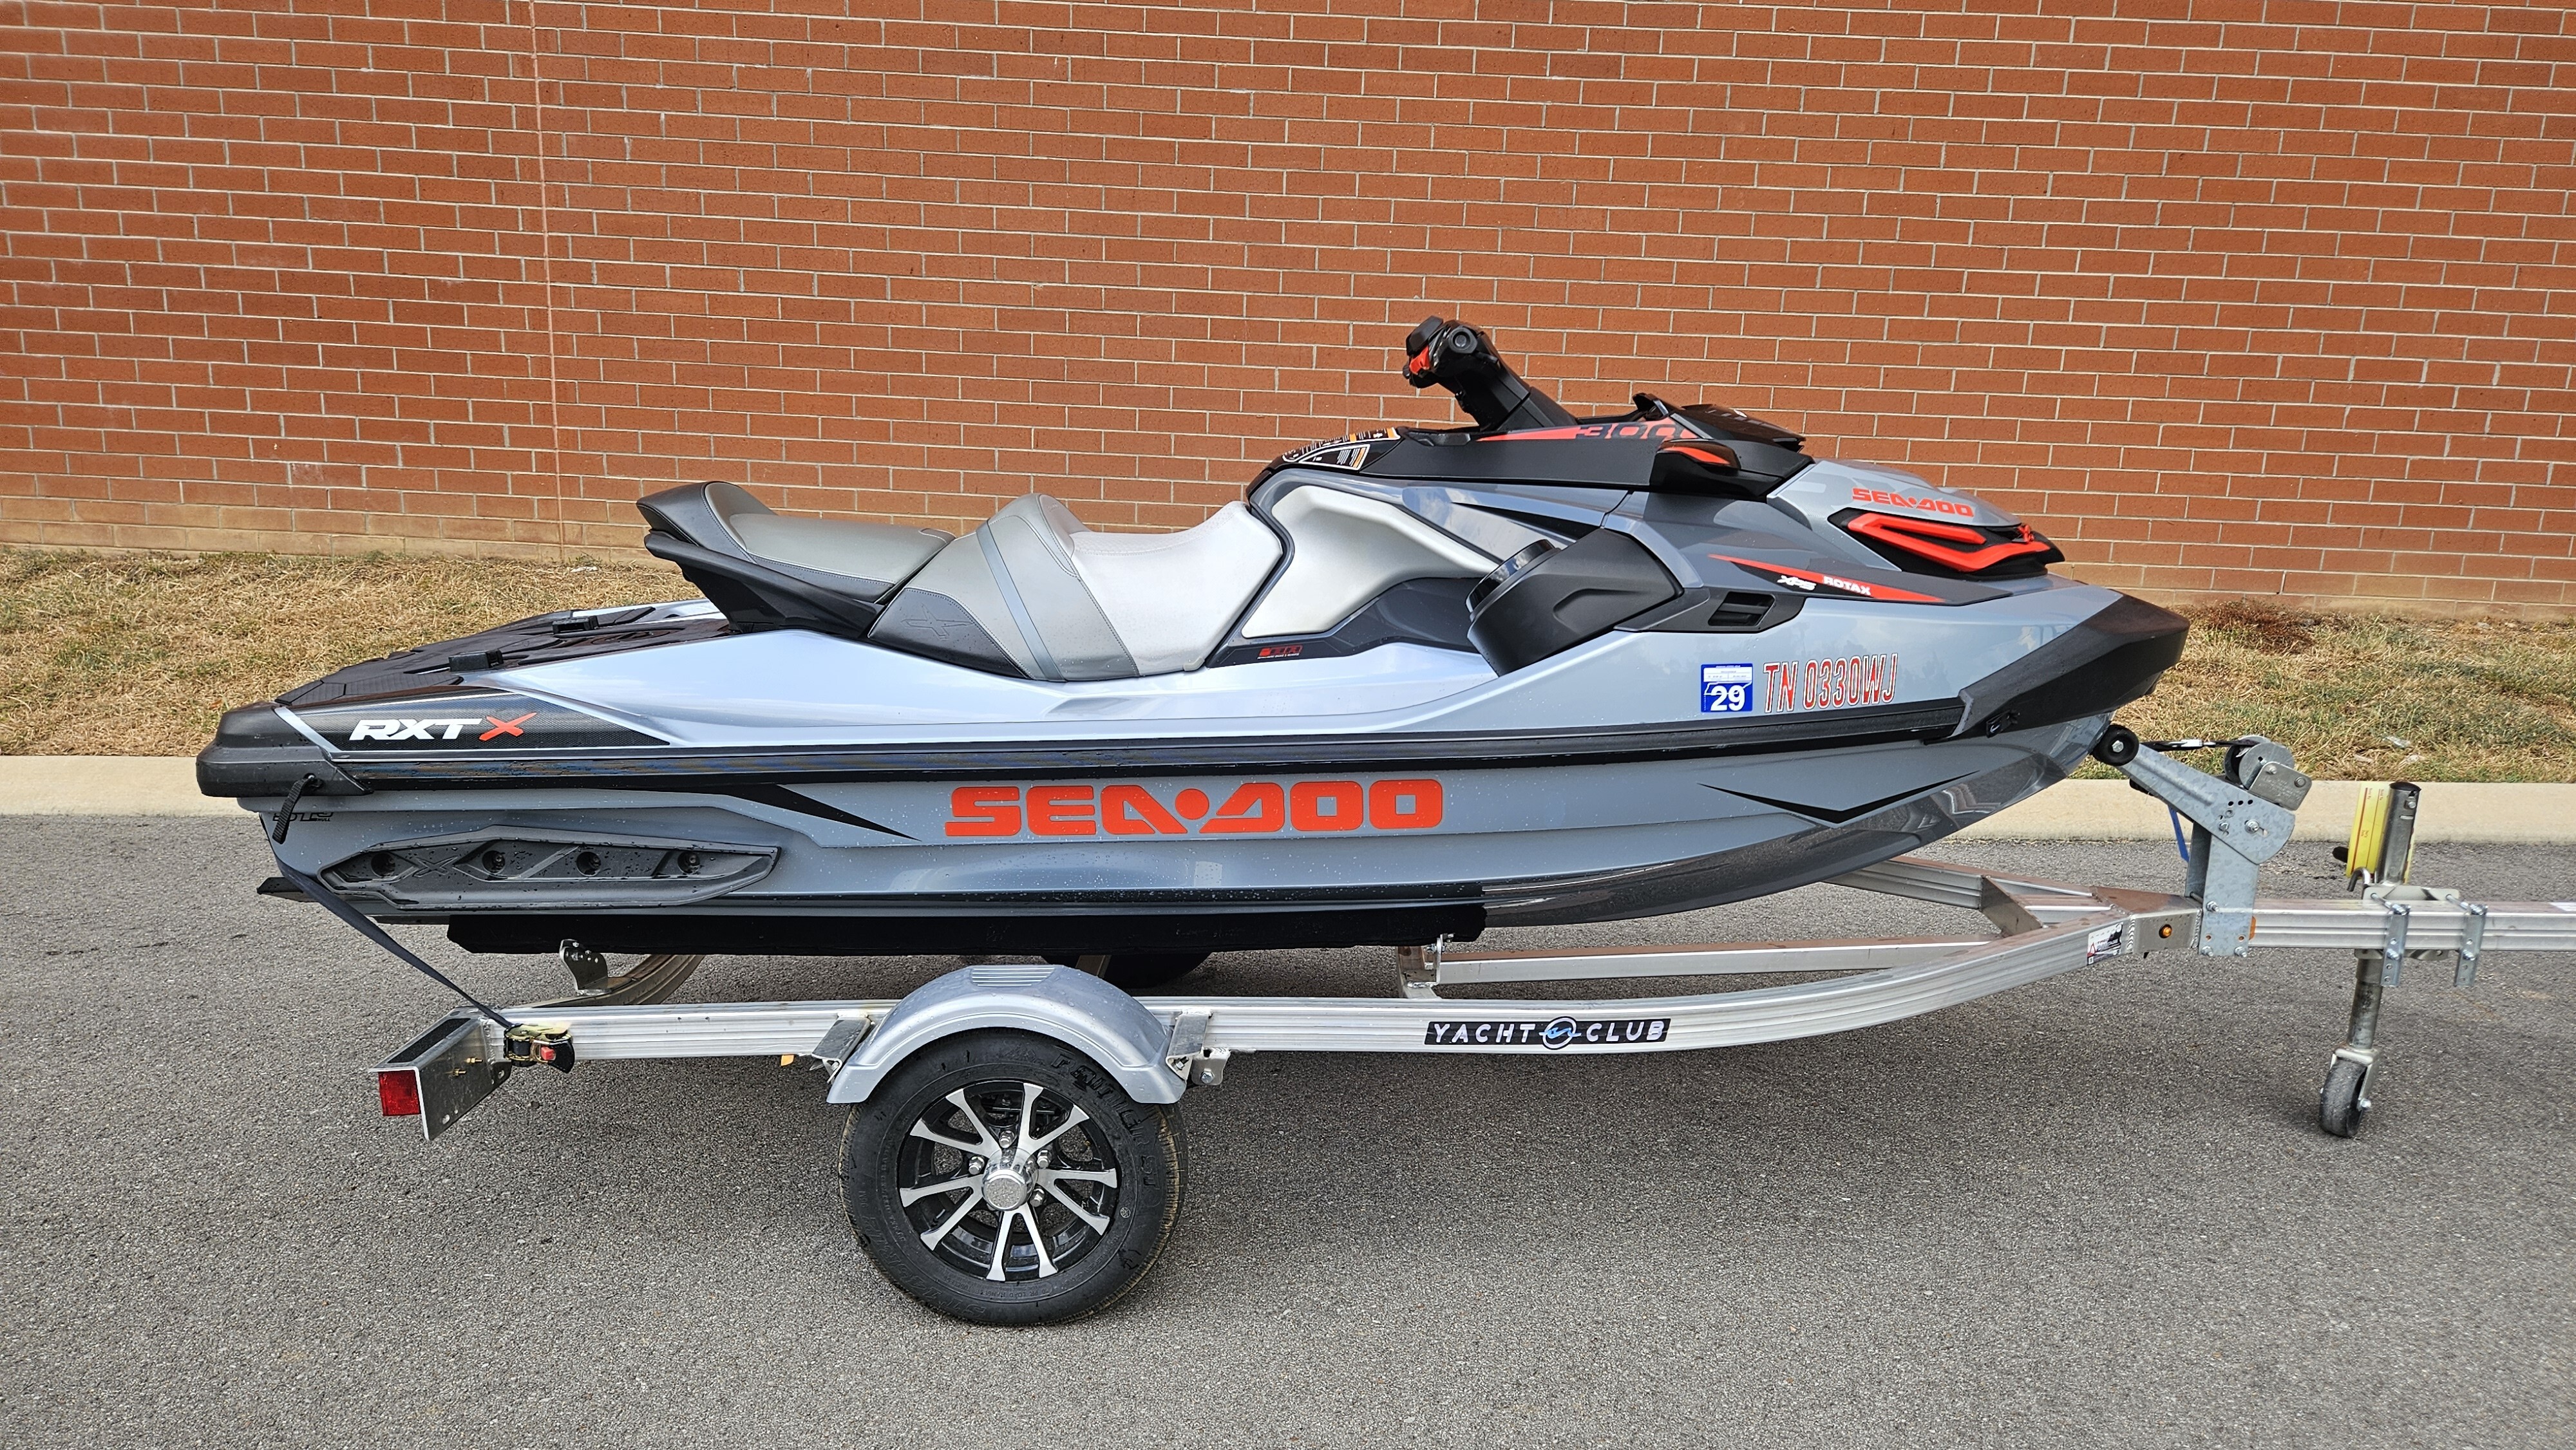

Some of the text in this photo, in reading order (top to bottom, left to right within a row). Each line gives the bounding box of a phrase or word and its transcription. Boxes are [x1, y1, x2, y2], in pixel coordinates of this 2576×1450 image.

[1823, 576, 1871, 596] ROTAX
[1764, 653, 1899, 713] TN 0330WJ
[1710, 684, 1745, 711] 29
[349, 712, 538, 741] RXT X
[1434, 1021, 1665, 1043] YACHT CLUB
